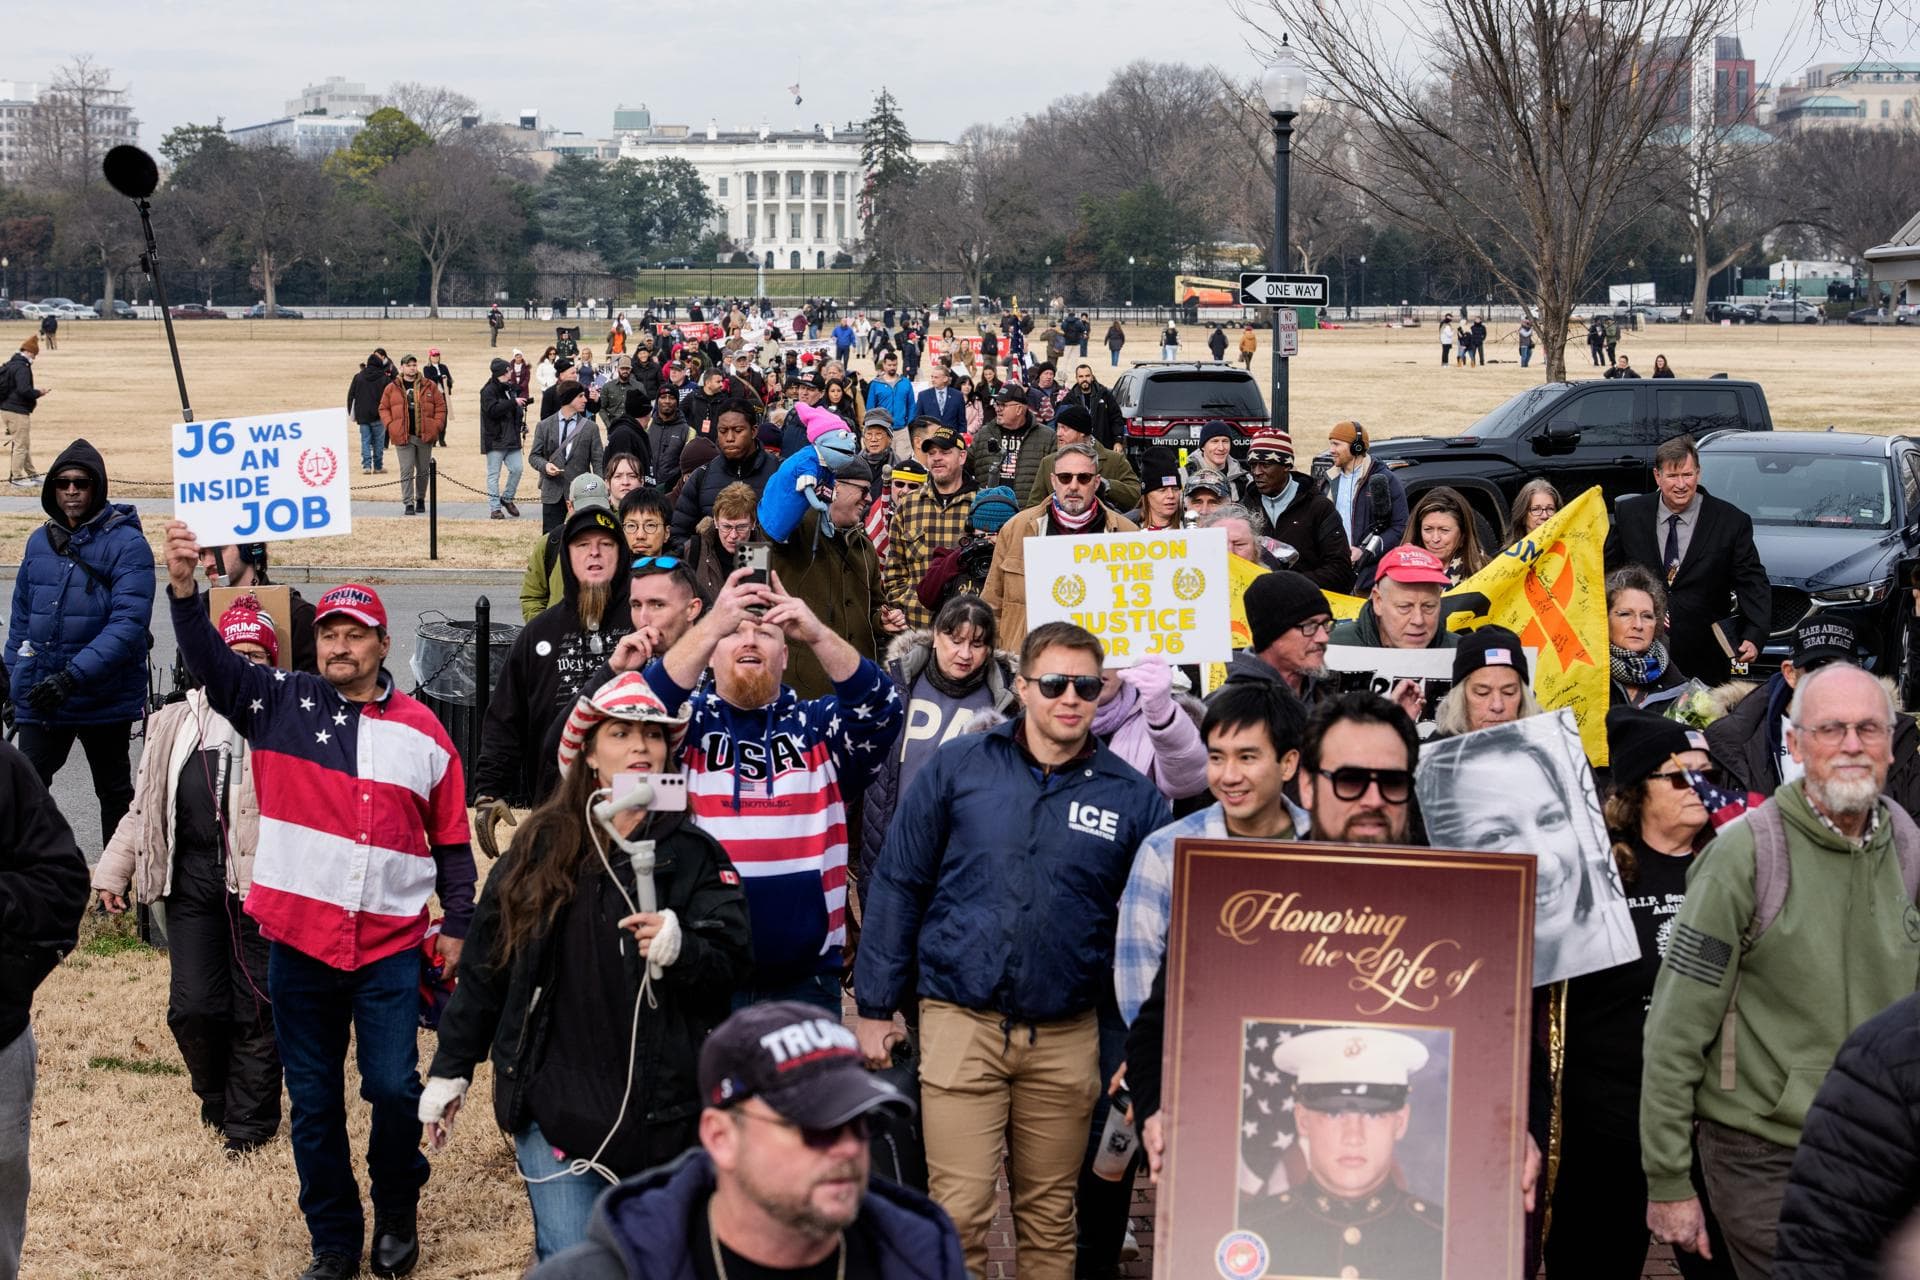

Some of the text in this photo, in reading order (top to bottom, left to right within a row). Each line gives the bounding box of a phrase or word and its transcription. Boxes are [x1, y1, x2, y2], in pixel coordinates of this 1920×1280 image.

[1267, 284, 1318, 297] ONE WAY
[1280, 323, 1297, 332] PARKING
[1284, 312, 1293, 322] NO
[177, 421, 302, 458] J6 WAS
[1152, 438, 1179, 446] UNITED
[240, 447, 279, 471] AN
[180, 475, 270, 504] INSIDE
[233, 495, 331, 536] JOB
[1073, 539, 1187, 564] PARDON
[1106, 562, 1154, 583] THE
[324, 589, 372, 604] TRUMP
[334, 598, 358, 607] 2020
[1112, 583, 1151, 608] 13
[224, 621, 261, 637] TRUMP
[1070, 608, 1196, 635] JUSTICE
[1798, 623, 1855, 640] MAKE AMERICA
[1100, 632, 1185, 657] OR J6
[1802, 635, 1852, 650] GREAT AGAIN
[706, 731, 809, 782] USA
[1068, 801, 1120, 835] ICE
[1628, 895, 1659, 908] R.I.P.
[1216, 889, 1408, 962] Honoring
[1299, 936, 1486, 1015] the Life of
